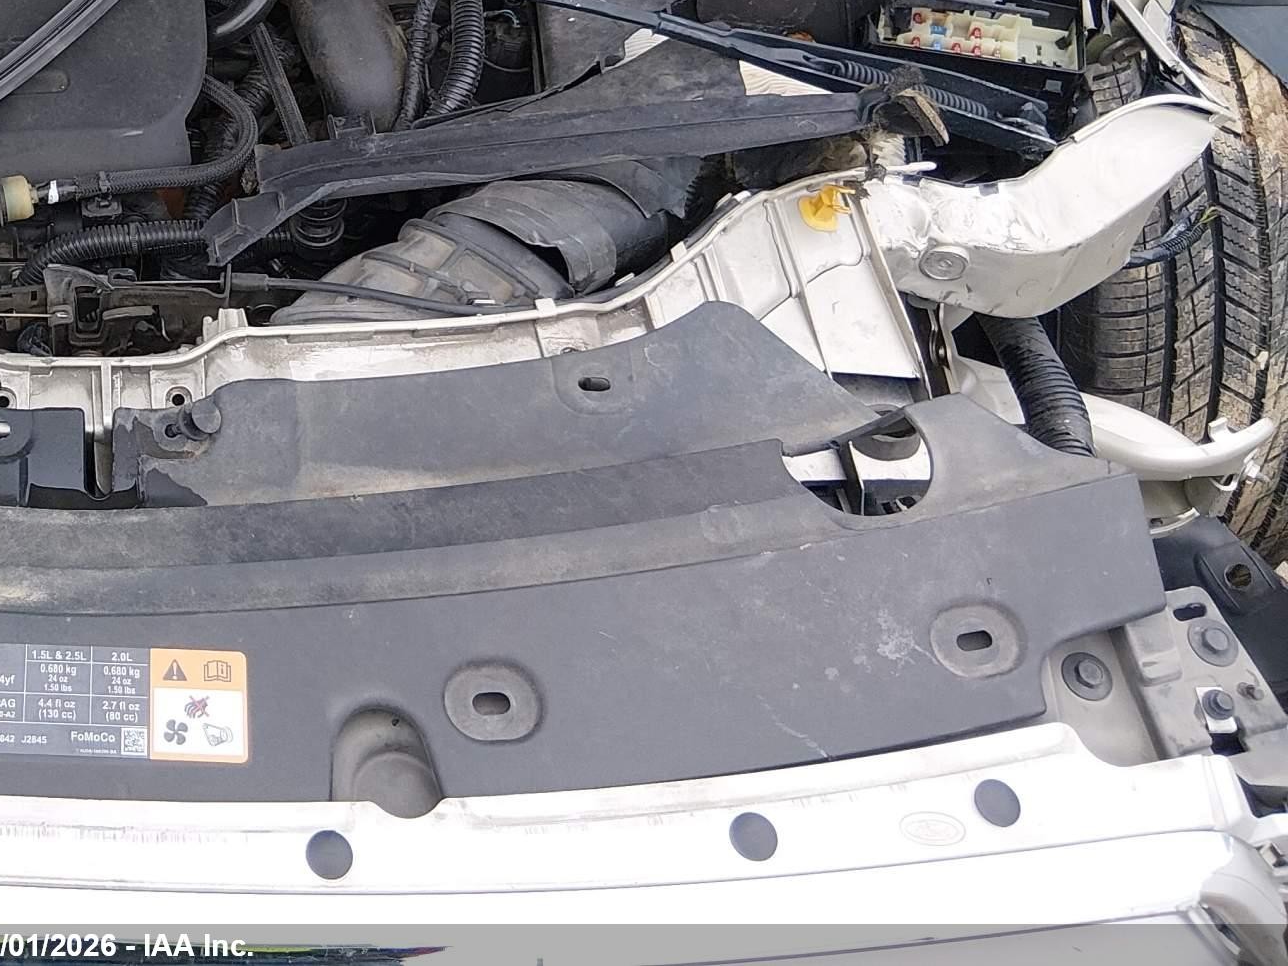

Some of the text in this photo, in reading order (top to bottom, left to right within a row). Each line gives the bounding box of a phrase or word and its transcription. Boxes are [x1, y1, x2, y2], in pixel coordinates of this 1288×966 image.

[31, 649, 88, 661] 1.5L & 2.5L
[111, 651, 133, 662] 2.0L
[40, 663, 77, 676] 0.680 kg
[103, 665, 140, 679] 0.680 kg
[48, 674, 69, 683] 24 oz
[111, 676, 132, 685] 24 oz
[44, 683, 73, 692] 1.50 lbs
[107, 685, 136, 695] 1.50 lbs
[37, 698, 76, 709] 4.4 fl oz
[102, 700, 140, 711] 2.7 fl oz
[38, 708, 77, 722] (130 cc)
[105, 711, 139, 724] (80 cc)
[20, 735, 48, 745] J2845
[70, 731, 116, 743] FoMoCo
